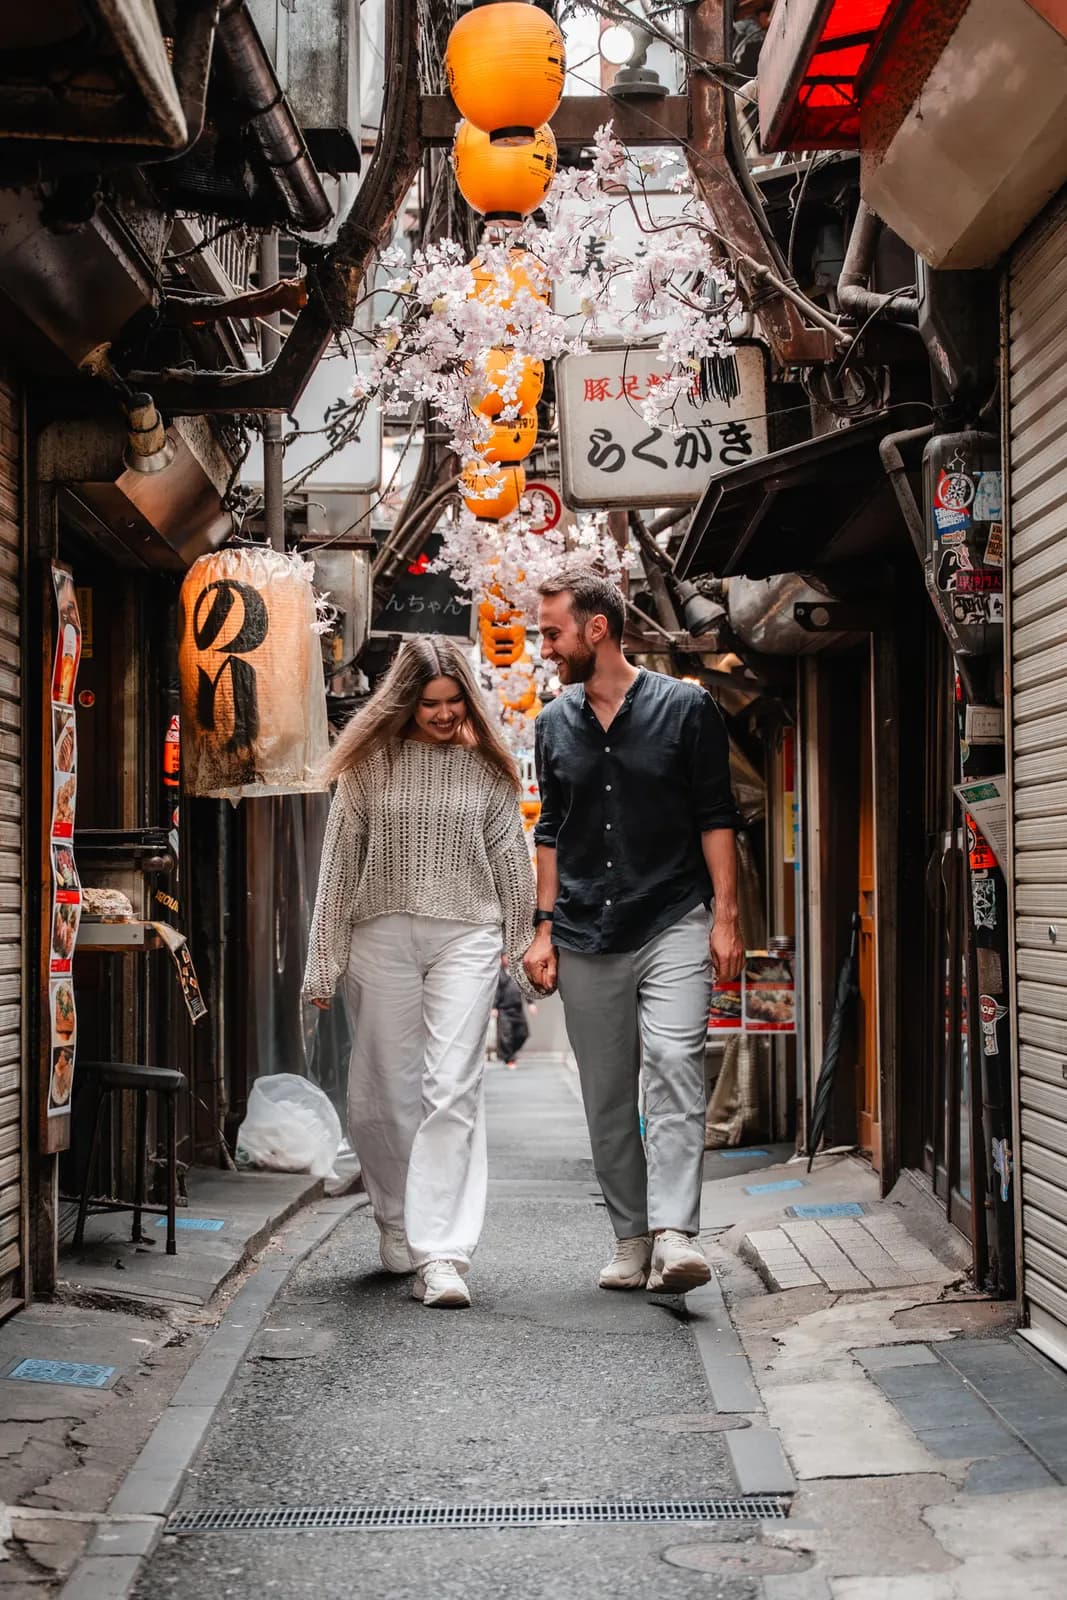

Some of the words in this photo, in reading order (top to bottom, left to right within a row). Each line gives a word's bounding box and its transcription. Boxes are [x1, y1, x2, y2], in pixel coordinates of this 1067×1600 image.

[586, 419, 752, 473] らくがき
[384, 593, 463, 616] んちゃん
[193, 578, 269, 752] のり
